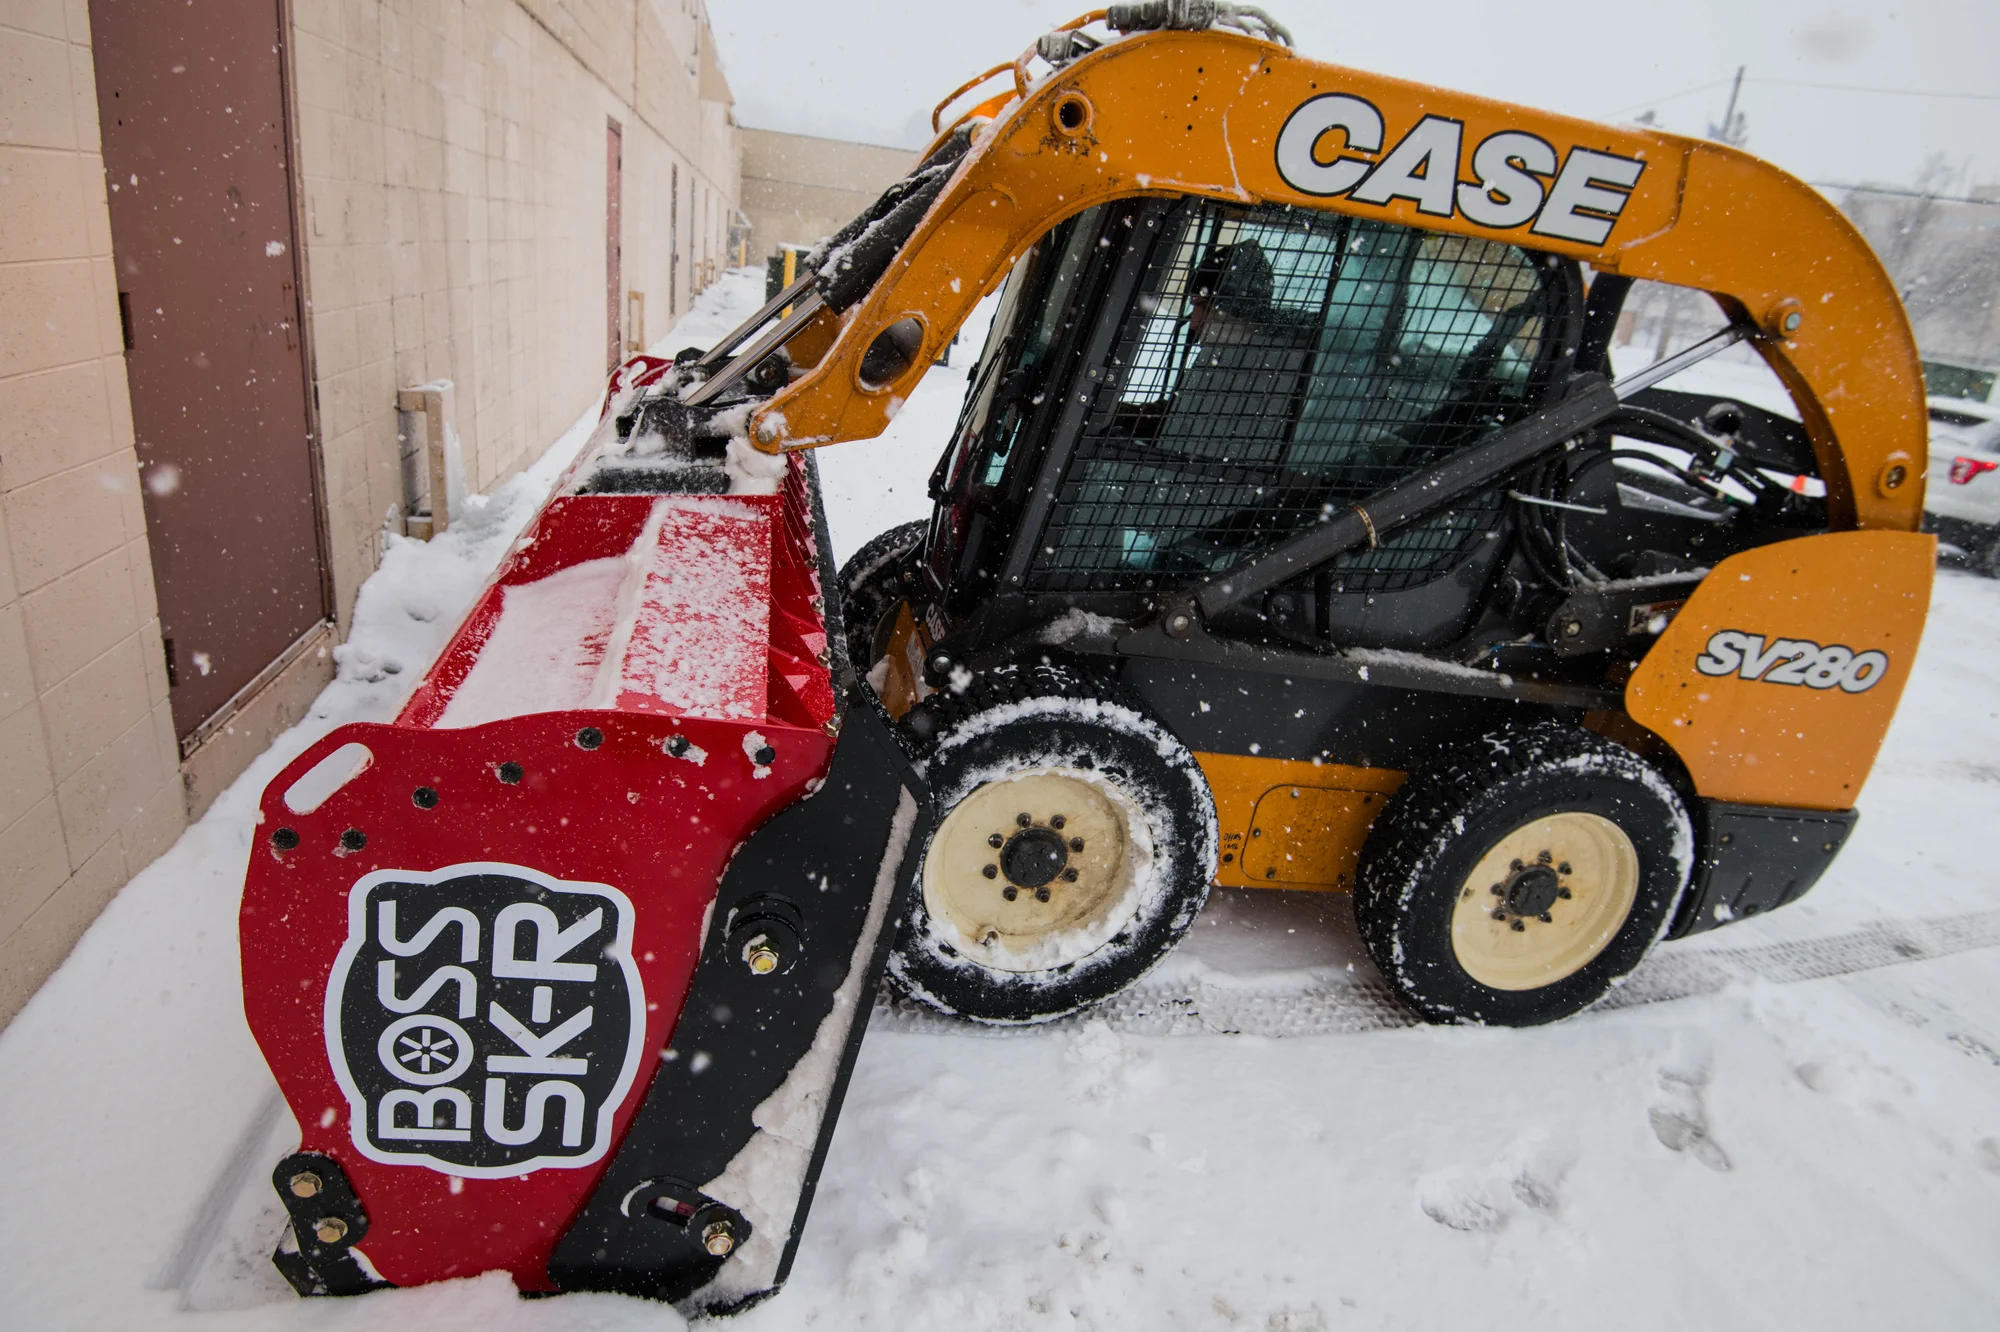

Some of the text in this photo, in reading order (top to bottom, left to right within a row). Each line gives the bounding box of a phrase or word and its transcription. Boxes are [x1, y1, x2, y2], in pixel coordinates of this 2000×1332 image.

[1274, 92, 1648, 247] CASE
[1696, 629, 1889, 694] SV280
[378, 900, 480, 1142] BOSS
[484, 902, 603, 1147] SK-R
